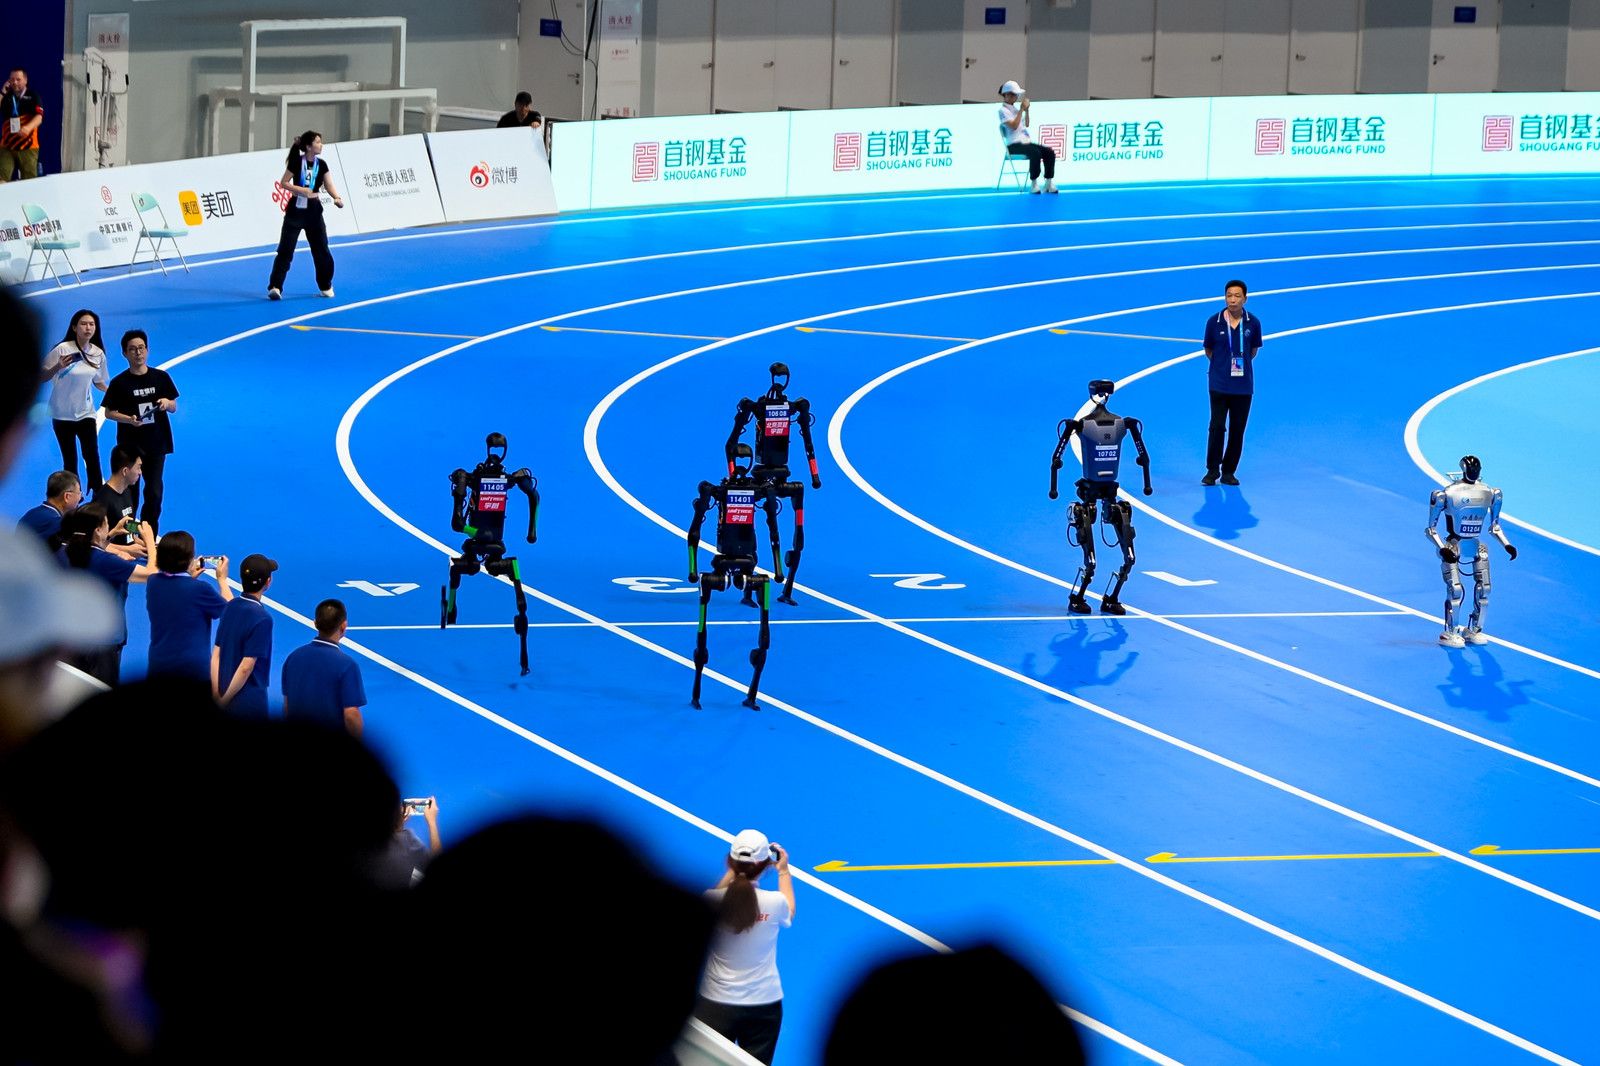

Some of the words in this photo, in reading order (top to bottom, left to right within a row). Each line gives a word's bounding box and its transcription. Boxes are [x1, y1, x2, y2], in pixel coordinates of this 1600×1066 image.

[1073, 119, 1164, 150] 首钢基金
[1291, 115, 1386, 144] 首钢基金
[1520, 113, 1600, 141] 首钢基
[866, 127, 953, 158] 首钢基金
[1291, 145, 1352, 155] SHOUGANG
[1355, 144, 1386, 154] FUND
[1519, 141, 1583, 152] SHOUGANG
[1586, 141, 1600, 151] FU
[664, 135, 747, 168] 首钢基金
[1072, 150, 1132, 162] SHOUGANG
[1134, 149, 1164, 160] FUND
[866, 158, 922, 171] SHOUGANG
[925, 156, 953, 168] FUND
[363, 167, 417, 187] 北京机器人租赁
[491, 165, 518, 185] 微博
[663, 169, 718, 181] SHOUGANG
[720, 166, 747, 178] FUND
[103, 206, 119, 216] ICBC
[182, 200, 199, 215] 美团
[200, 191, 234, 219] 美团
[336, 580, 420, 597] 4
[611, 576, 700, 593] 3
[869, 573, 966, 590] 2
